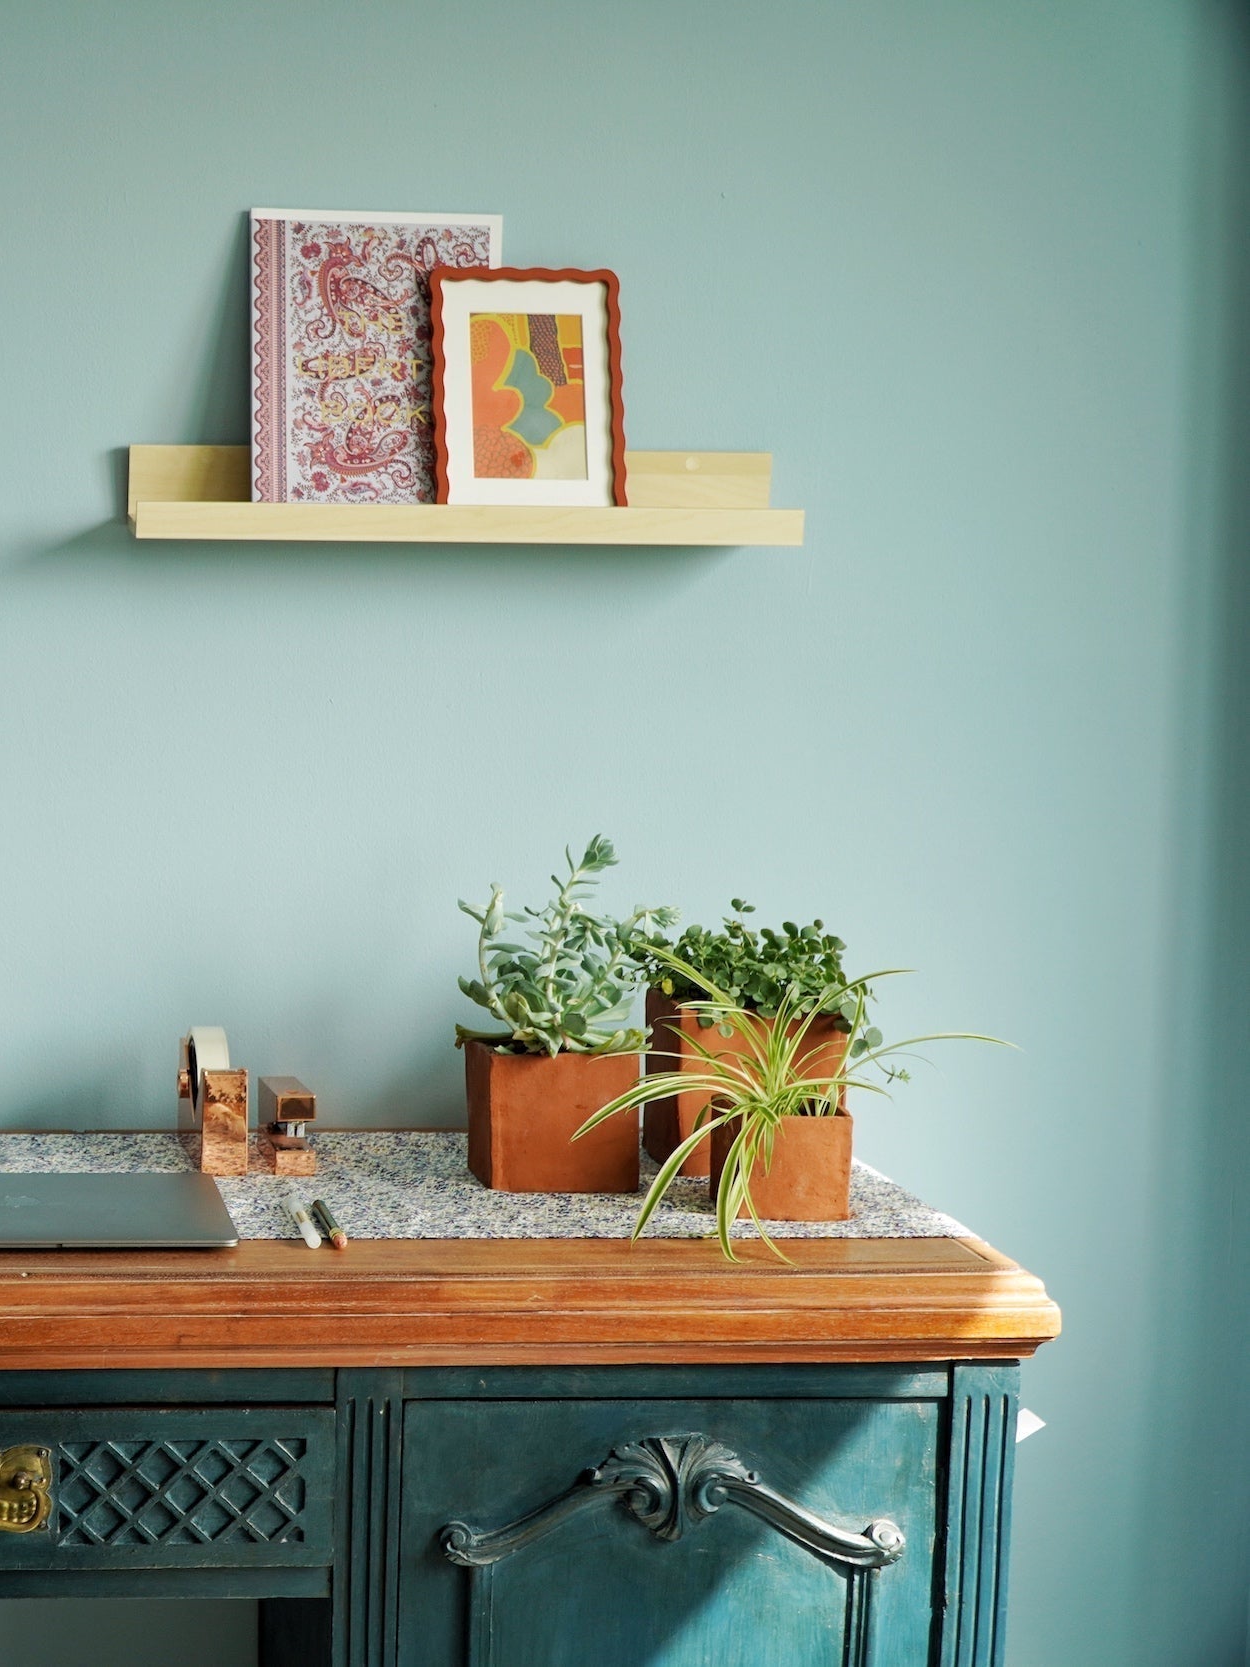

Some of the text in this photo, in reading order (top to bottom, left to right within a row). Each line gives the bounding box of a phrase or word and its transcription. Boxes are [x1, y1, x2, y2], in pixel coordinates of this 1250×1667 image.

[338, 310, 406, 335] THE
[298, 355, 423, 380] LIBERT
[321, 401, 428, 425] BOOK
